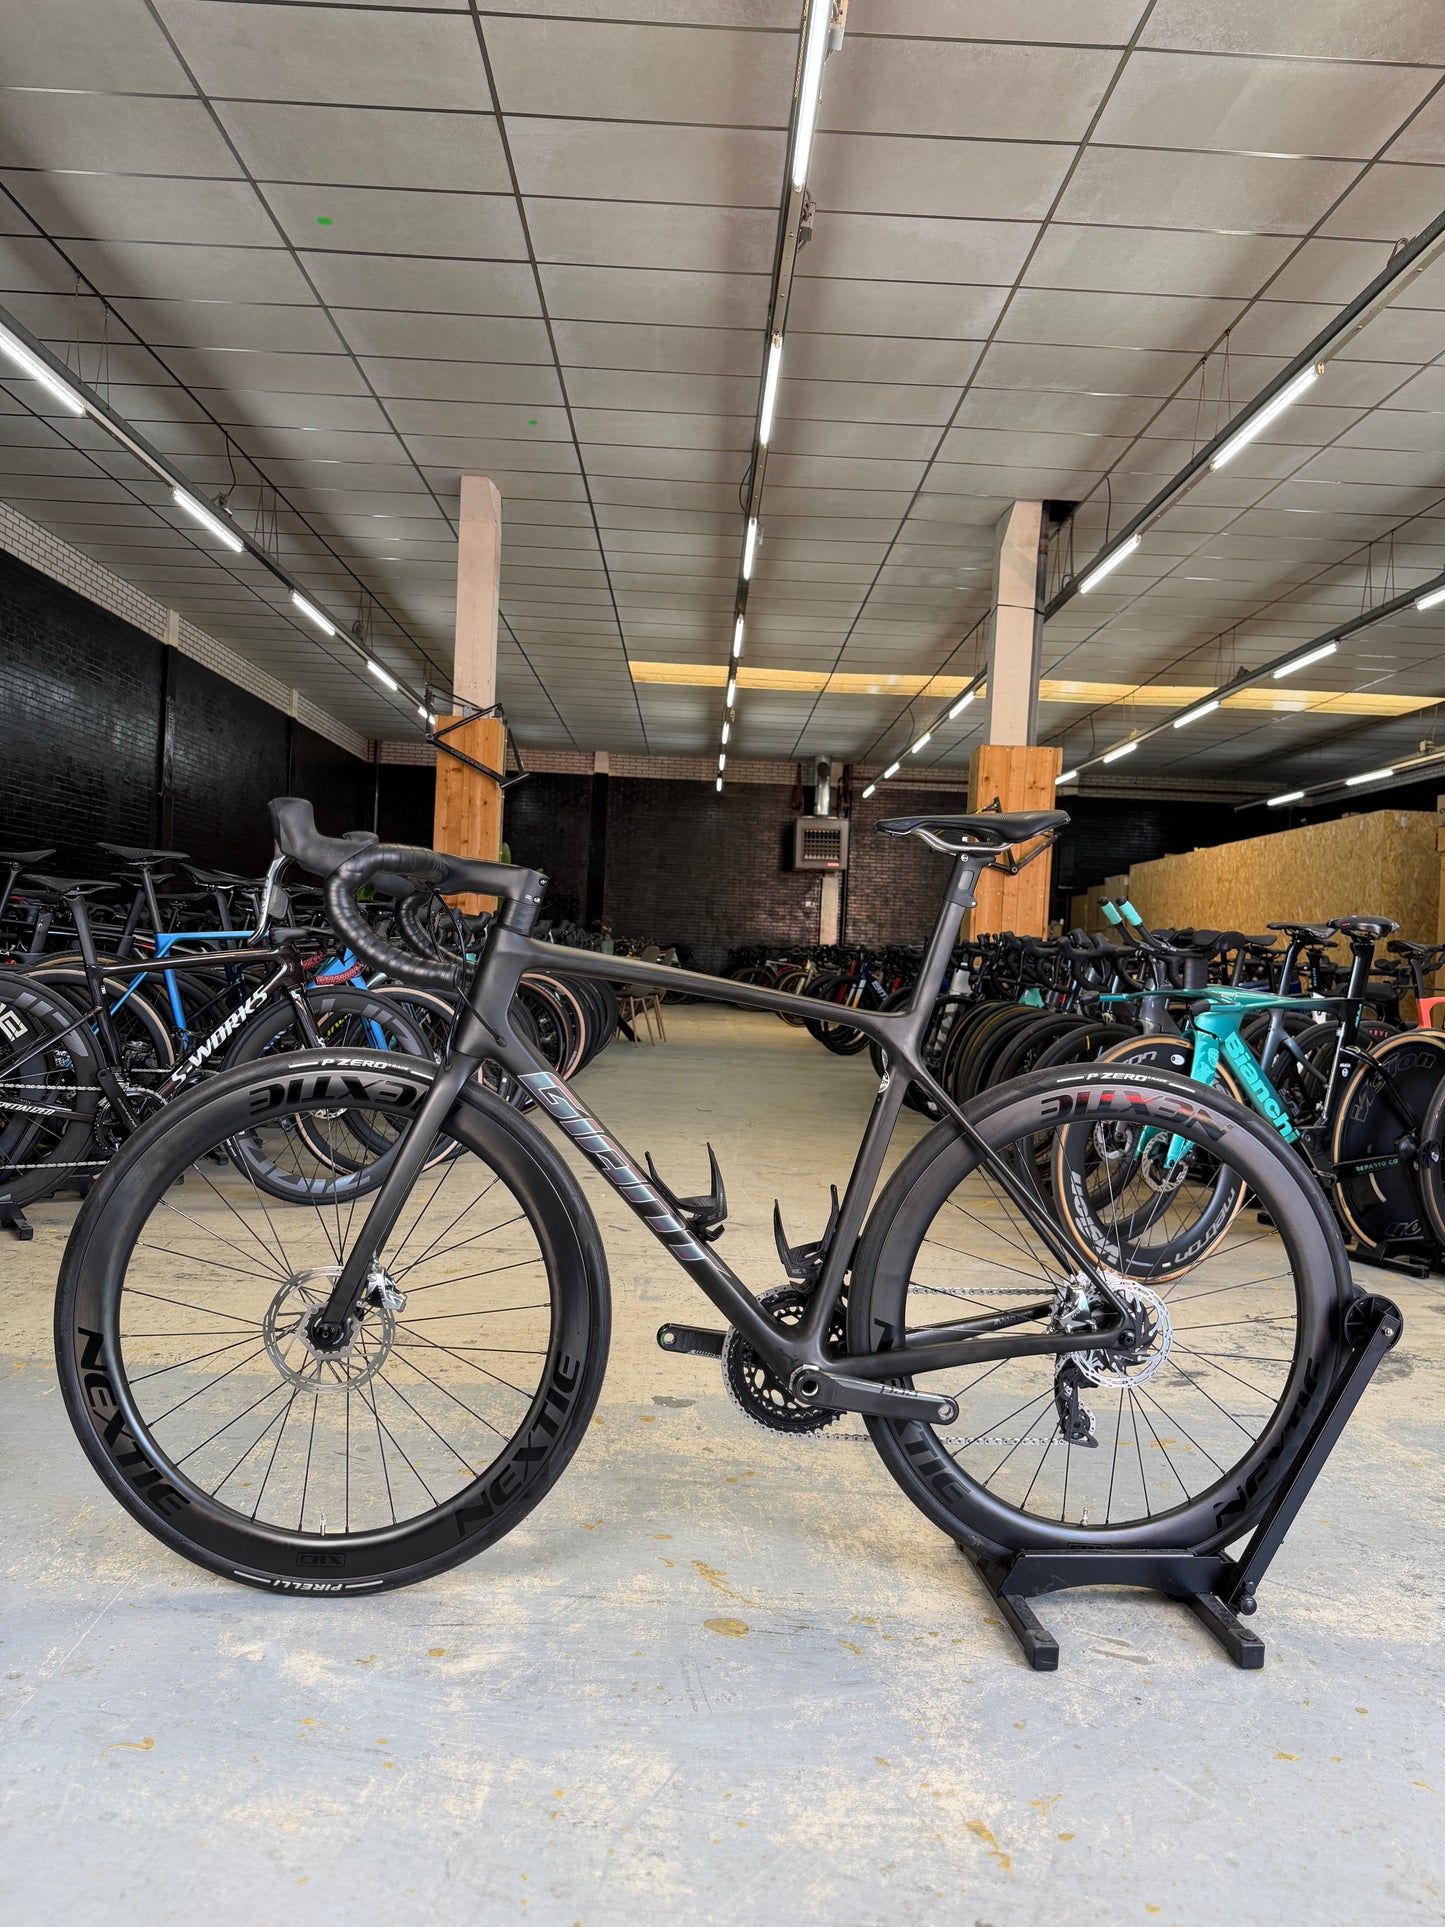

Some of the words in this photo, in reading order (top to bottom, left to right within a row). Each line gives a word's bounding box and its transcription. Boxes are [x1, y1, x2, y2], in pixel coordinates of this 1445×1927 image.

[171, 984, 268, 1090] S-WORKS
[321, 1058, 335, 1066] P
[337, 1058, 389, 1069] ZERO
[1040, 1089, 1234, 1142] NEXTIE
[1101, 1072, 1148, 1082] ZERO
[1224, 1031, 1301, 1144] Bianchi
[518, 1071, 729, 1277] GIANT
[78, 1326, 192, 1518] NEXTIE
[455, 1351, 581, 1538] NEXTIE
[272, 1579, 344, 1592] PIRELLI
[299, 1555, 343, 1566] CRX
